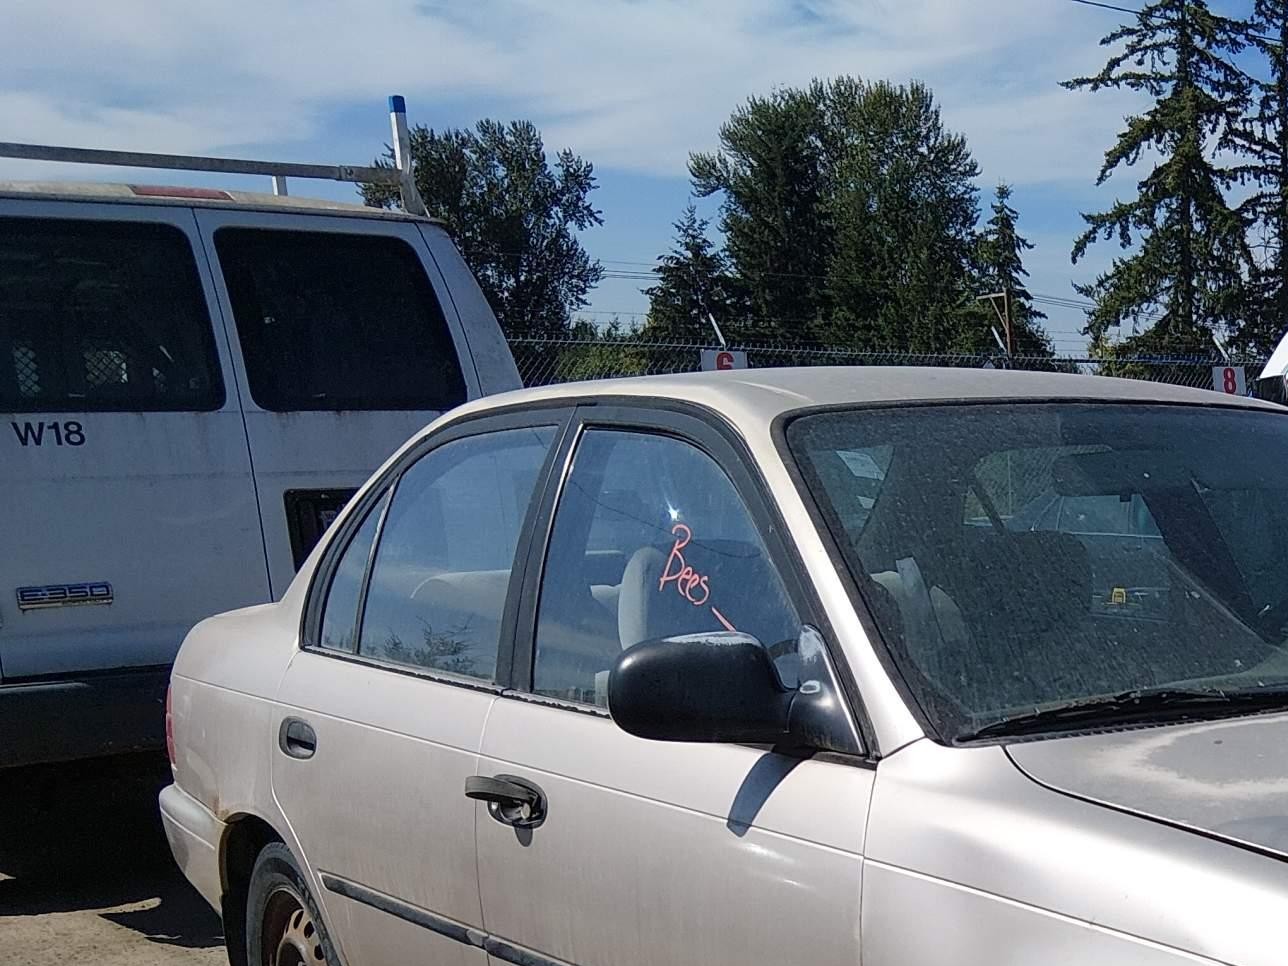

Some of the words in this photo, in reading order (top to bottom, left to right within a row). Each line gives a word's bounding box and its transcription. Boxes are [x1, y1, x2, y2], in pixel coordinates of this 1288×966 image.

[1223, 367, 1237, 394] 8
[11, 421, 86, 446] W18
[659, 523, 710, 606] Bees
